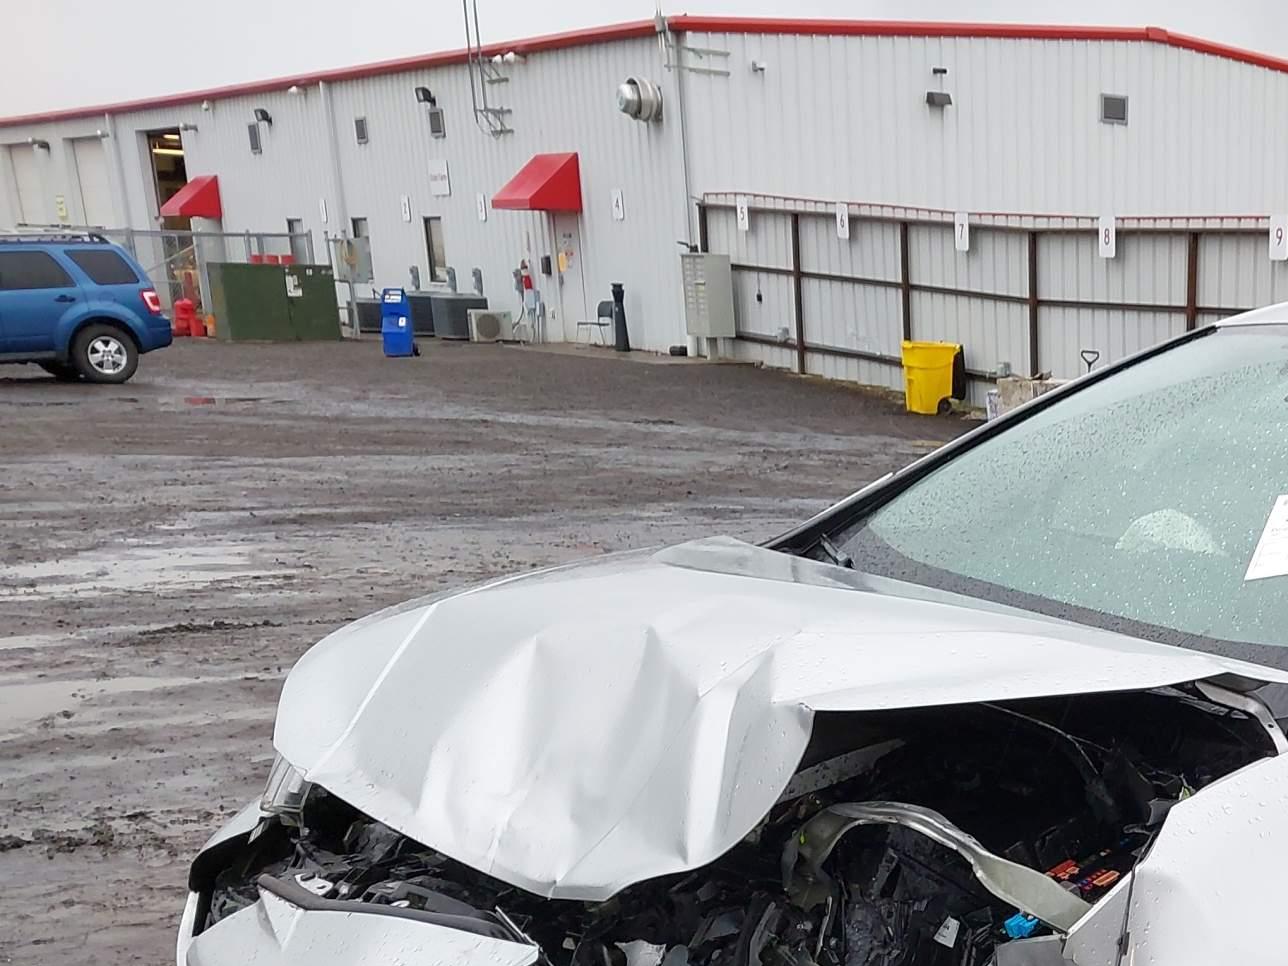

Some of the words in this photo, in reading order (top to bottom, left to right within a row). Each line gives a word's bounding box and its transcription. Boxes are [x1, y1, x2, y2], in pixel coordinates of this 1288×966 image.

[739, 206, 745, 221] 5
[839, 215, 845, 229] 6
[958, 223, 964, 240] 7
[1103, 228, 1110, 246] 8
[1275, 227, 1283, 246] 9
